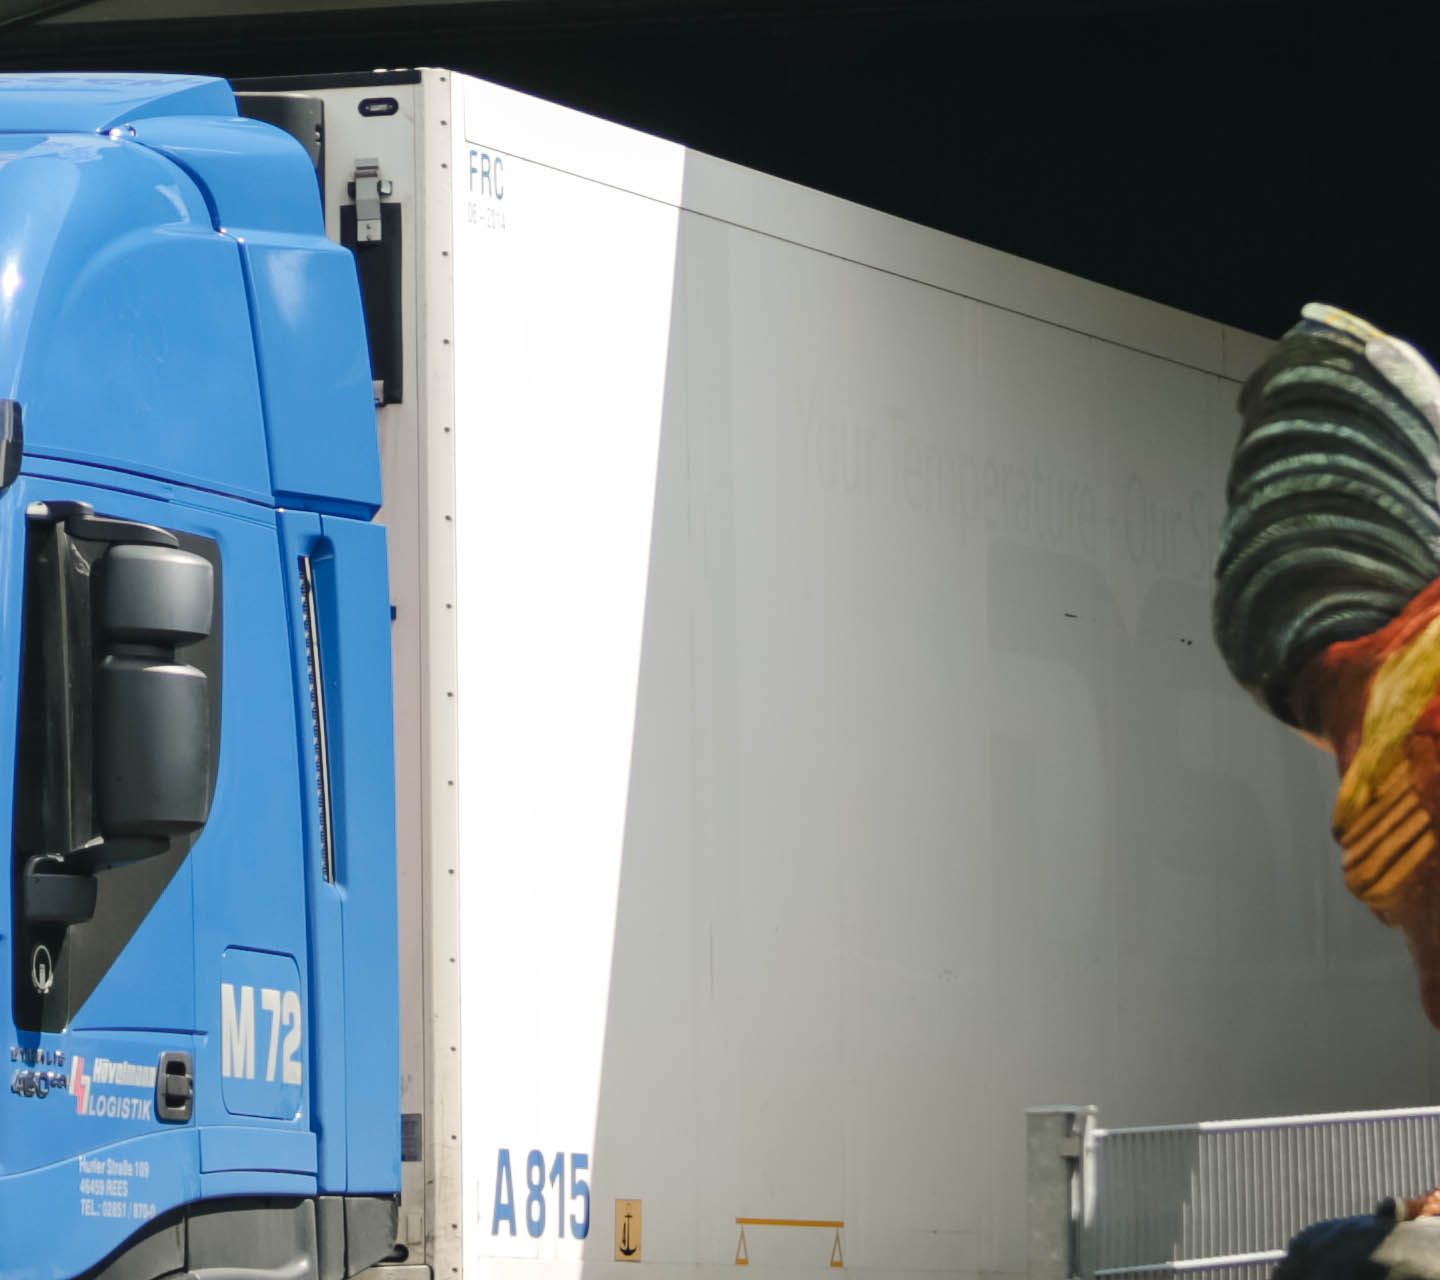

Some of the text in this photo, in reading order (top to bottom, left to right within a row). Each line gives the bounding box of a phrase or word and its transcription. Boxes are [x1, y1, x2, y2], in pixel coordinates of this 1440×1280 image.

[469, 149, 504, 200] FRC
[221, 983, 302, 1085] M 72
[88, 1096, 153, 1121] LOGISTIK
[106, 1179, 129, 1197] REES
